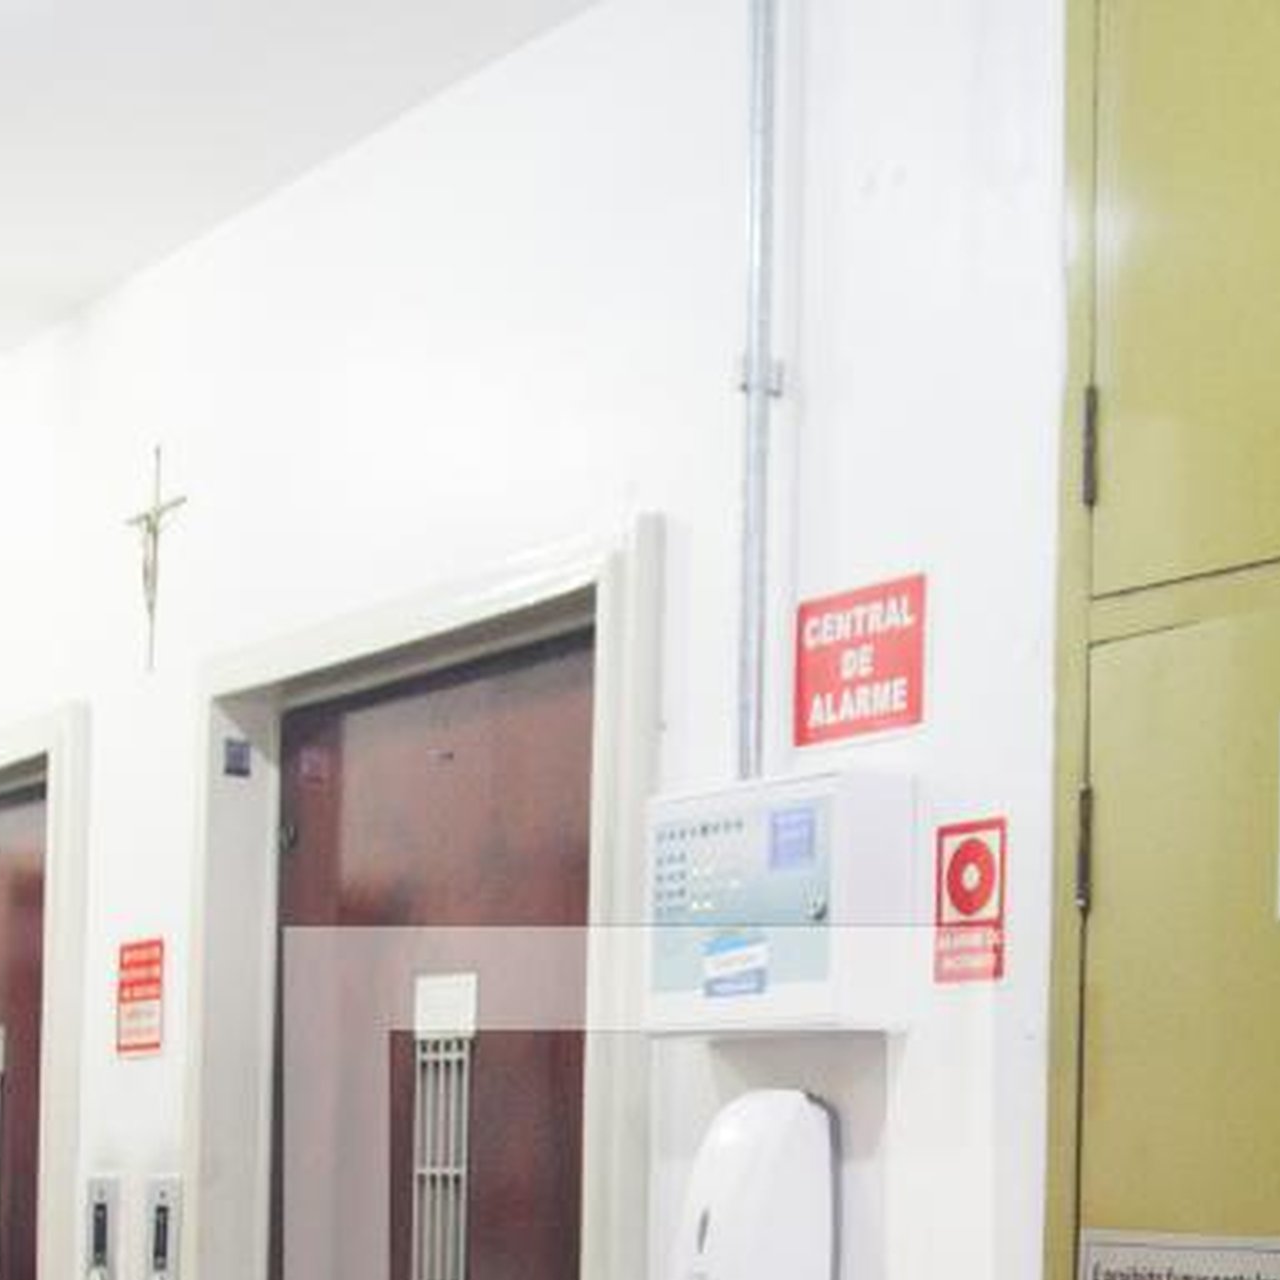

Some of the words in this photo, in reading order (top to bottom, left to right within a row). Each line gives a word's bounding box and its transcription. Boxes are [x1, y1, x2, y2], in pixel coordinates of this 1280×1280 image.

[803, 595, 915, 650] CENTRAL
[841, 645, 874, 679] DE
[809, 677, 908, 728] ALARME
